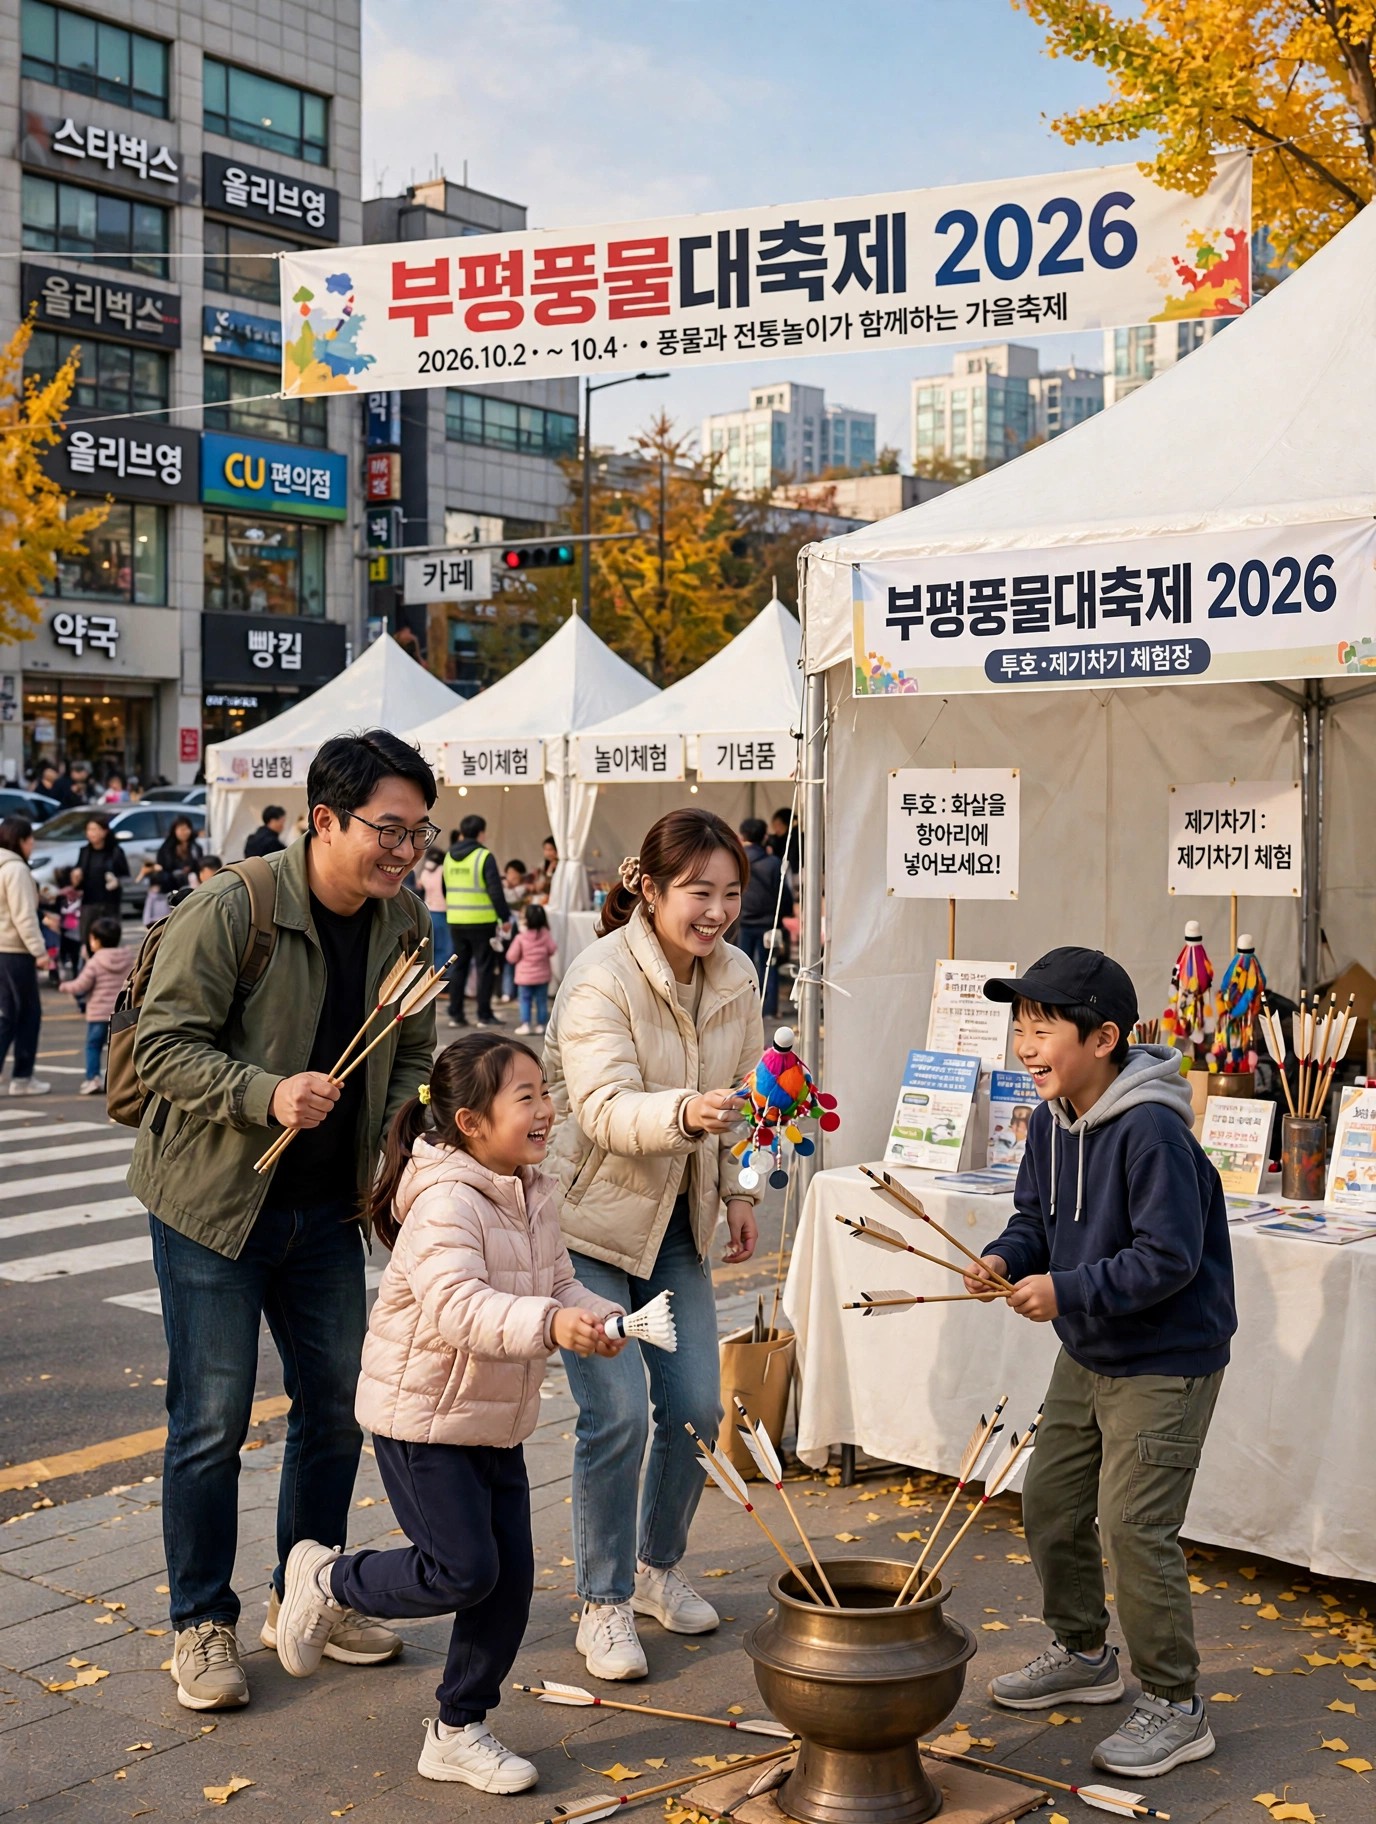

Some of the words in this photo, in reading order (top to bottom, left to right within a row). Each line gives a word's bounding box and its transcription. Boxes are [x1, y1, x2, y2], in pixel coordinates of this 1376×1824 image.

[53, 118, 179, 183] 스타벅스
[222, 167, 325, 228] 올리브영
[388, 211, 907, 337] 부평풍물대축제
[933, 191, 1139, 287] 2026
[41, 276, 164, 333] 올리벅스
[657, 325, 727, 356] 풍물과
[733, 312, 853, 350] 전통놀이가
[858, 304, 959, 338] 함께하는
[965, 291, 1068, 328] 가을축제
[67, 431, 182, 485] 올리브영
[224, 452, 266, 490] CU
[270, 462, 331, 500] 편의점
[423, 559, 473, 592] 카페
[885, 562, 1192, 641] 부평풍물대축제
[1206, 553, 1338, 620] 2026
[53, 613, 119, 658] 약국
[1130, 644, 1193, 671] 체험장
[462, 748, 528, 776] 놀이체험
[594, 744, 667, 773] 놀이체험
[716, 742, 776, 771] 기념품
[900, 793, 937, 816] 투호
[951, 793, 1006, 817] 화살을
[1185, 808, 1256, 834] 제기차기
[916, 823, 988, 846] 항아리에
[904, 852, 1001, 876] 넣어보세요!
[1177, 844, 1248, 870] 제기차기
[1254, 844, 1291, 870] 체험
